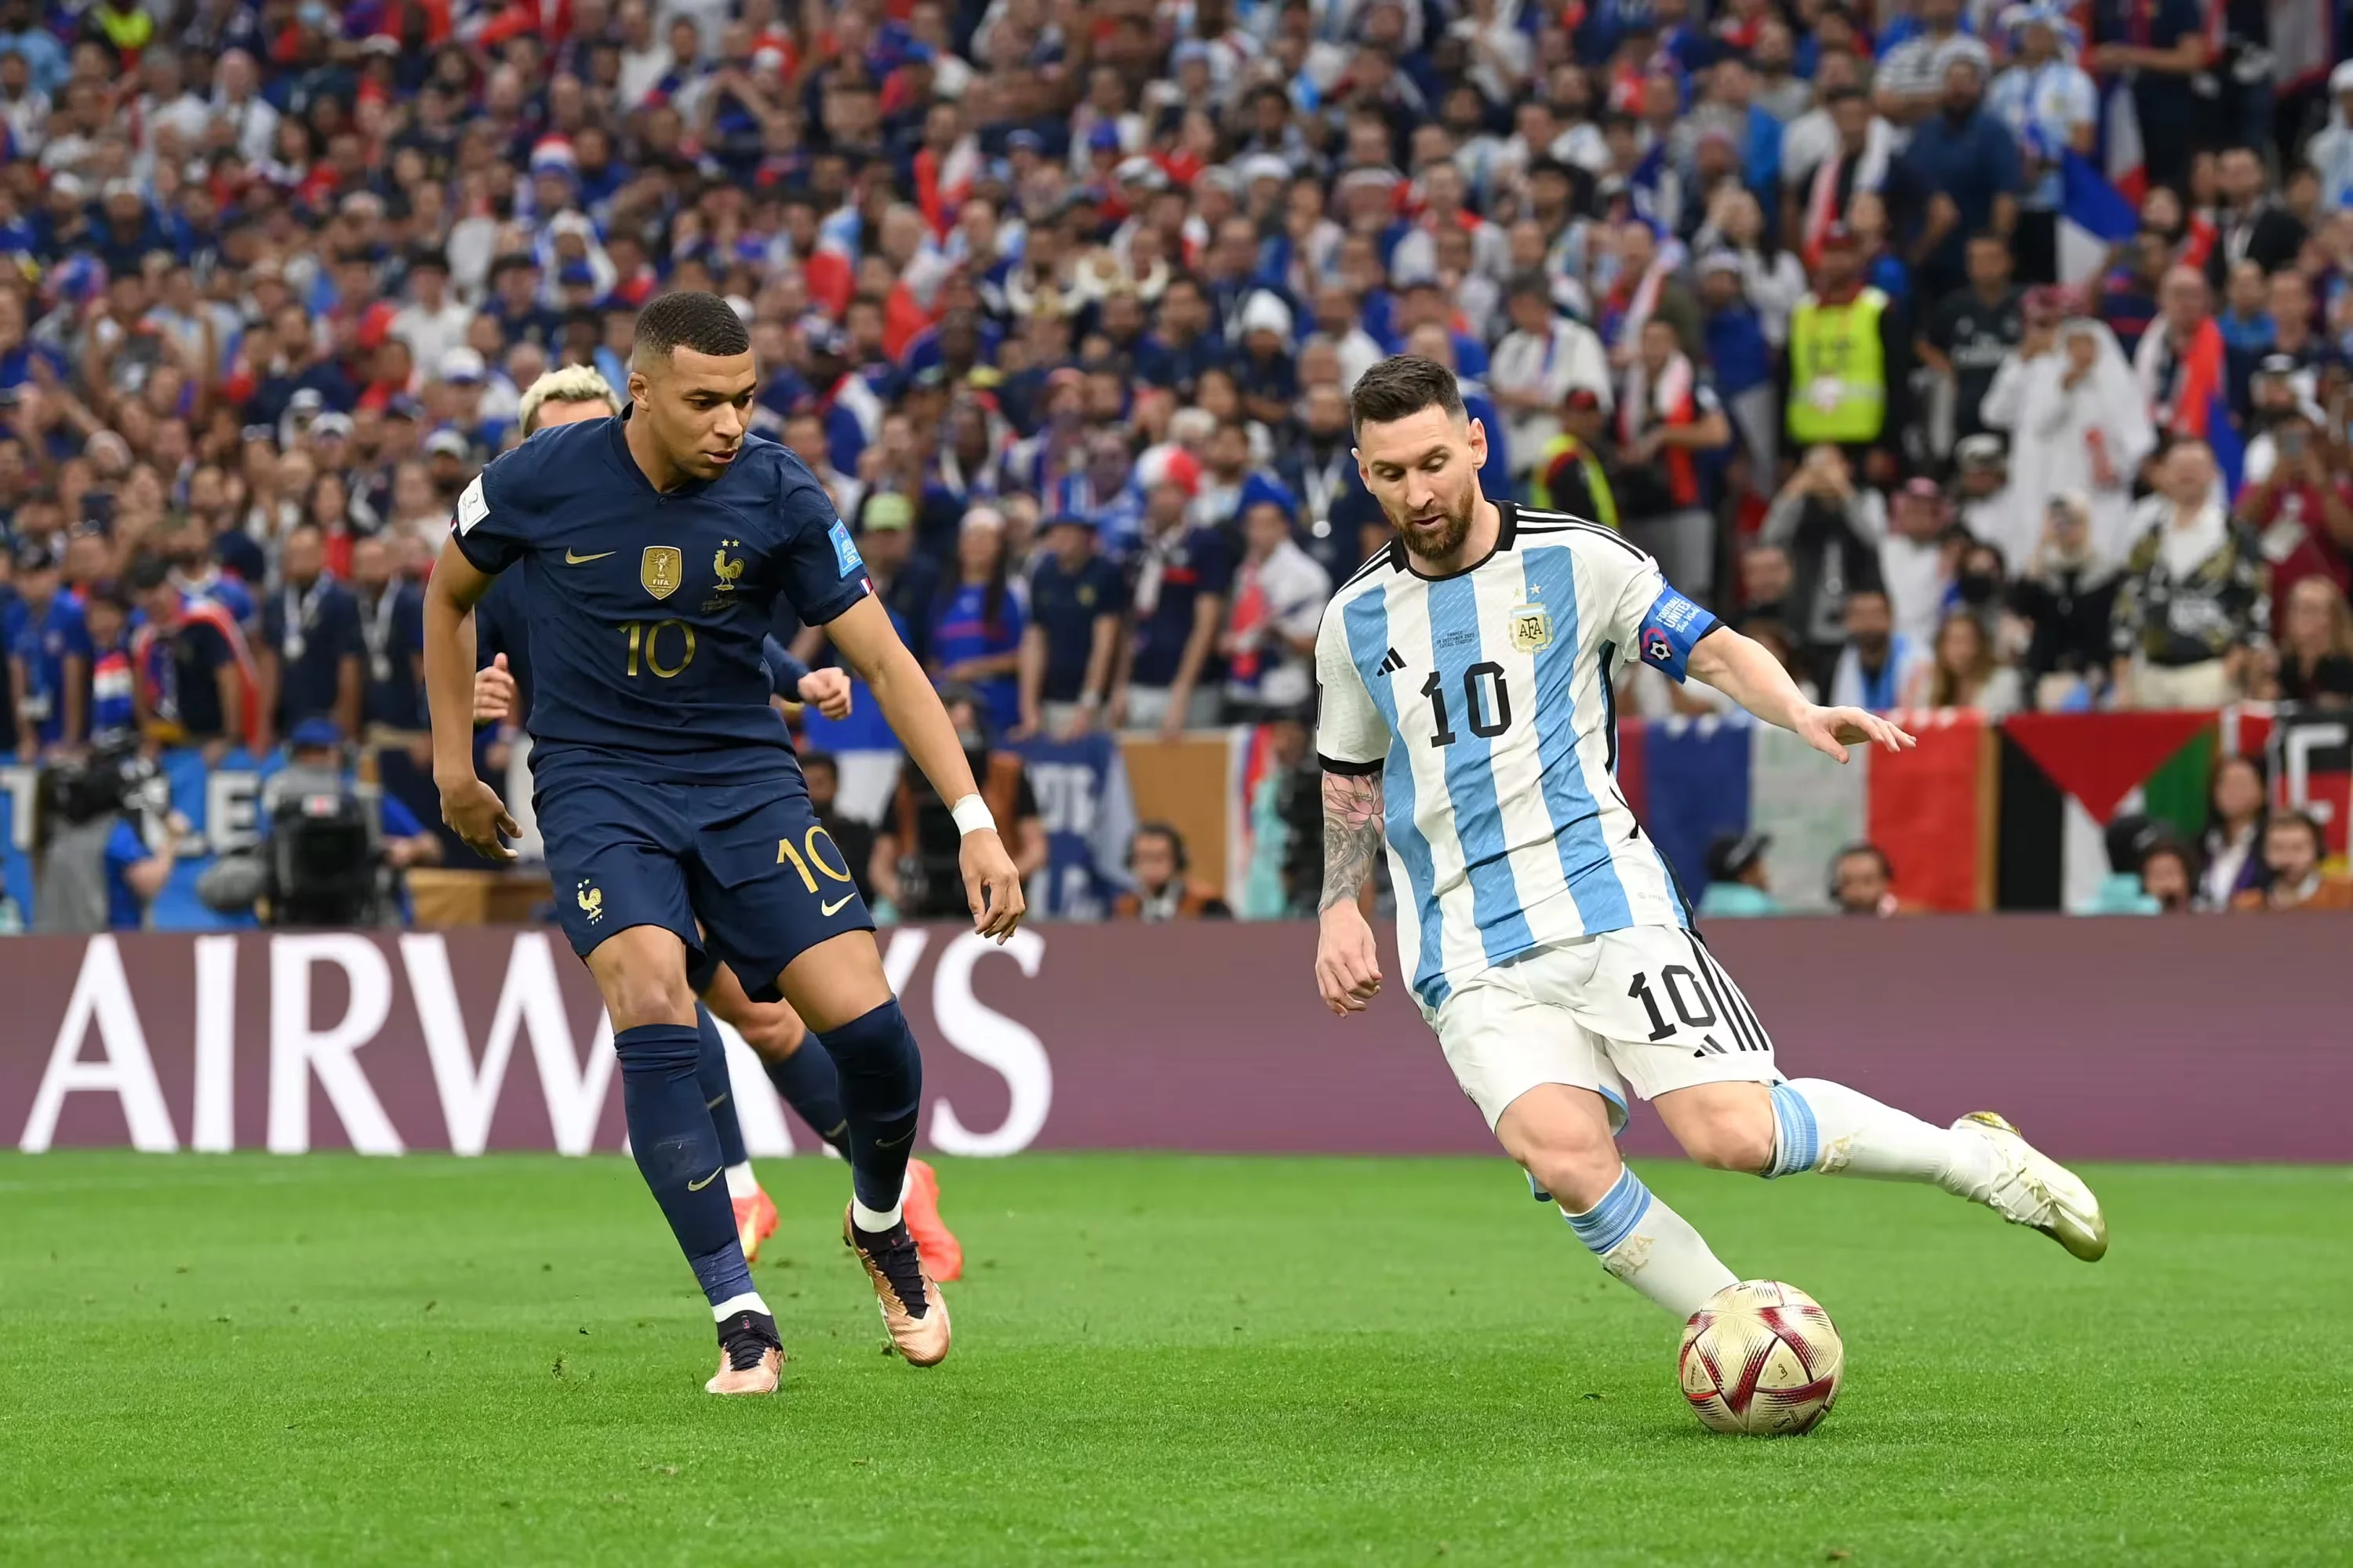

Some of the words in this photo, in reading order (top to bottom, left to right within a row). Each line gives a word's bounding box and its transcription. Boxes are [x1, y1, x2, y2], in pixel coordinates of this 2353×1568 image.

[1519, 617, 1543, 639] AFA
[1655, 596, 1680, 623] FOOTBALL
[1664, 601, 1691, 628] UNITES
[617, 617, 696, 678] 10
[1420, 661, 1512, 748] 10
[776, 825, 852, 893] 10
[1627, 965, 1717, 1042] 10
[19, 933, 1053, 1157] AIRWS
